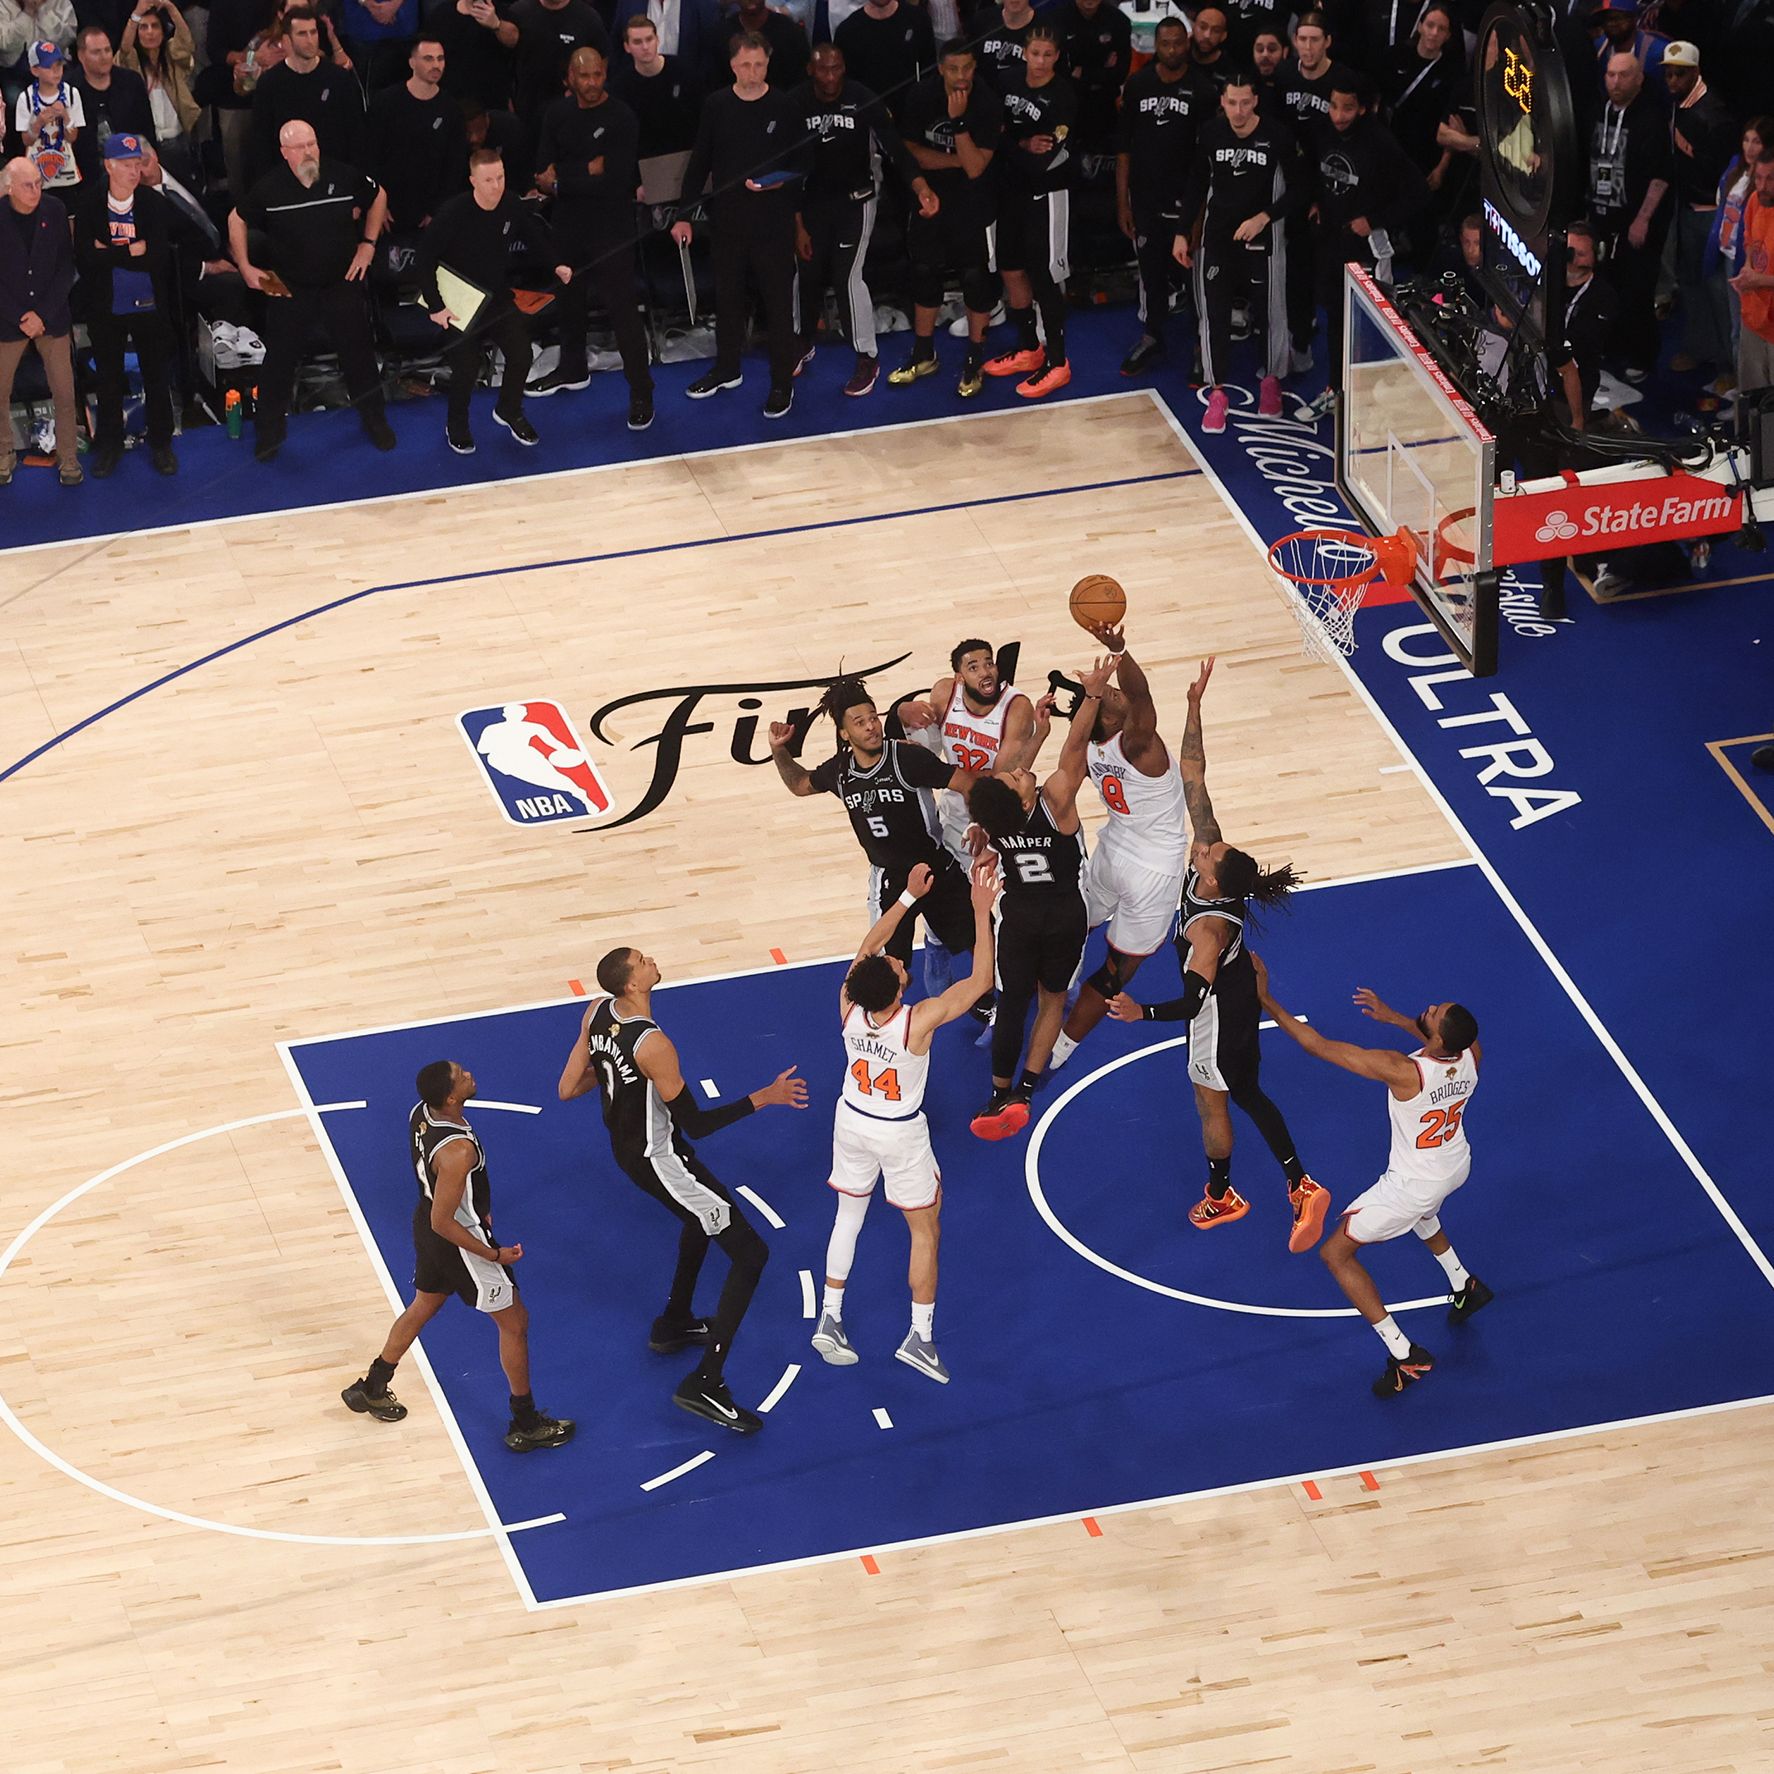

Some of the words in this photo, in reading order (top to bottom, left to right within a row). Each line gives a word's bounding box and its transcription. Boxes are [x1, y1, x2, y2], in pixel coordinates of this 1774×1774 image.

[983, 40, 1027, 61] SPUR
[1004, 94, 1042, 122] SPURS
[1140, 96, 1190, 117] SPURS
[1286, 92, 1331, 113] SPURS
[805, 114, 856, 135] SPURS
[1216, 148, 1267, 168] SPURS
[1582, 502, 1659, 537] State
[1659, 496, 1733, 527] Farm
[944, 722, 971, 741] NEW
[969, 728, 999, 753] YORK
[1382, 622, 1583, 831] ULTRA
[952, 743, 990, 771] 32
[515, 793, 573, 820] NBA
[845, 788, 905, 814] SPURS
[1101, 775, 1131, 815] 8
[866, 816, 889, 838] 5
[998, 835, 1052, 849] HARPER
[1014, 852, 1055, 883] 2
[850, 1037, 898, 1063] SHAMET
[851, 1058, 902, 1101] 44
[1429, 1080, 1471, 1105] BRIDGES
[1416, 1096, 1468, 1150] 25
